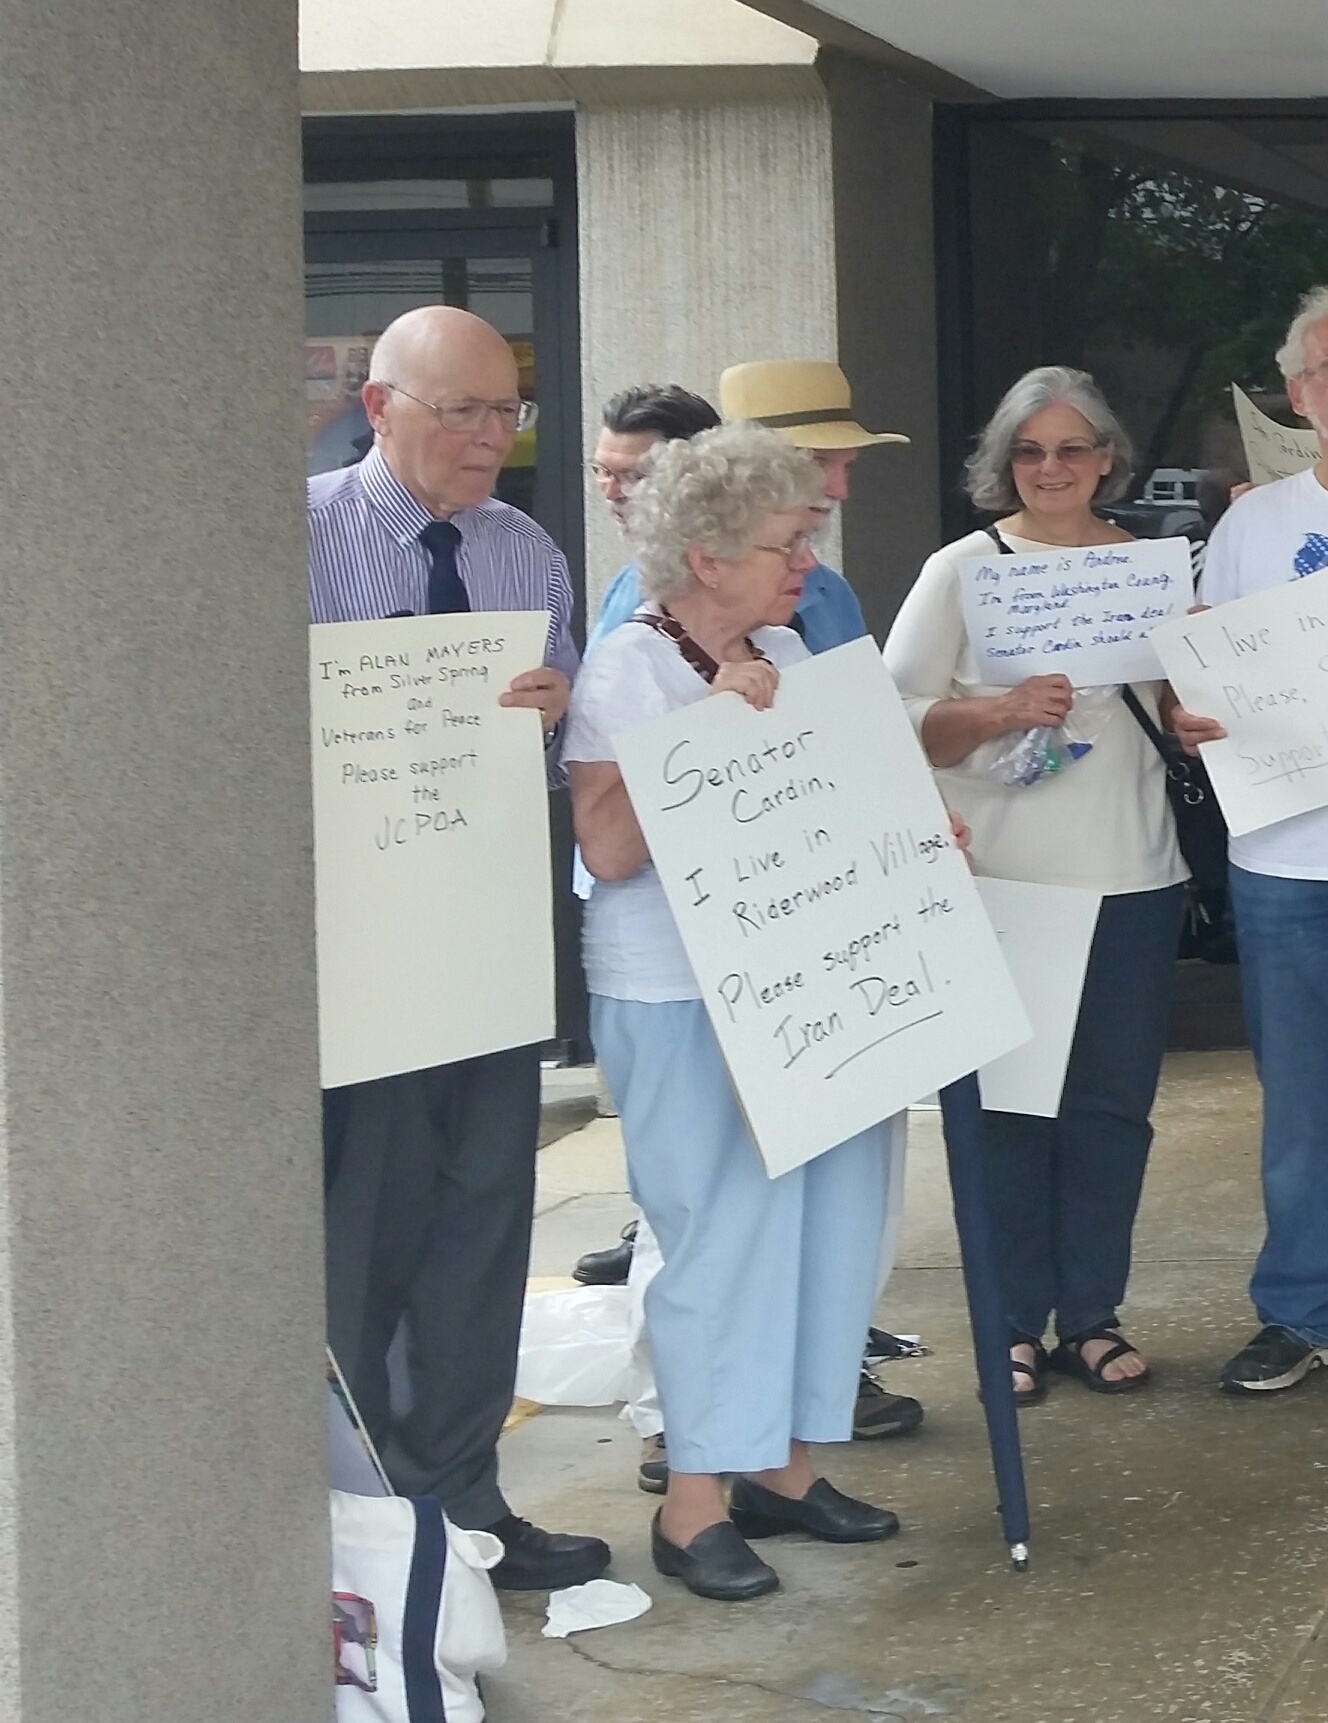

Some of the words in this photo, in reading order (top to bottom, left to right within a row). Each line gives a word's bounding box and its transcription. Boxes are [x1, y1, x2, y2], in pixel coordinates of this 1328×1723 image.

[1007, 563, 1049, 578] name
[1056, 557, 1073, 571] is
[319, 657, 352, 681] I'm
[359, 650, 410, 673] ALAN
[425, 638, 506, 665] MAYERS
[986, 643, 1036, 659] Senator
[1182, 632, 1209, 669] I
[1220, 625, 1271, 659] live
[1297, 612, 1326, 633] in
[341, 682, 383, 699] from
[390, 672, 433, 690] Silver
[438, 663, 490, 683] Spring
[406, 696, 433, 712] and
[320, 725, 396, 749] Veterans
[404, 716, 428, 734] for
[441, 709, 482, 729] Peace
[341, 761, 399, 784] Please
[408, 749, 479, 778] support
[661, 729, 814, 813] Senator
[411, 785, 440, 803] the
[684, 867, 711, 908] I
[804, 826, 831, 854] in
[732, 867, 859, 939] Riderwood
[716, 971, 806, 1025] Please
[822, 918, 903, 974] support
[915, 888, 956, 924] the
[773, 1010, 845, 1070] Iran
